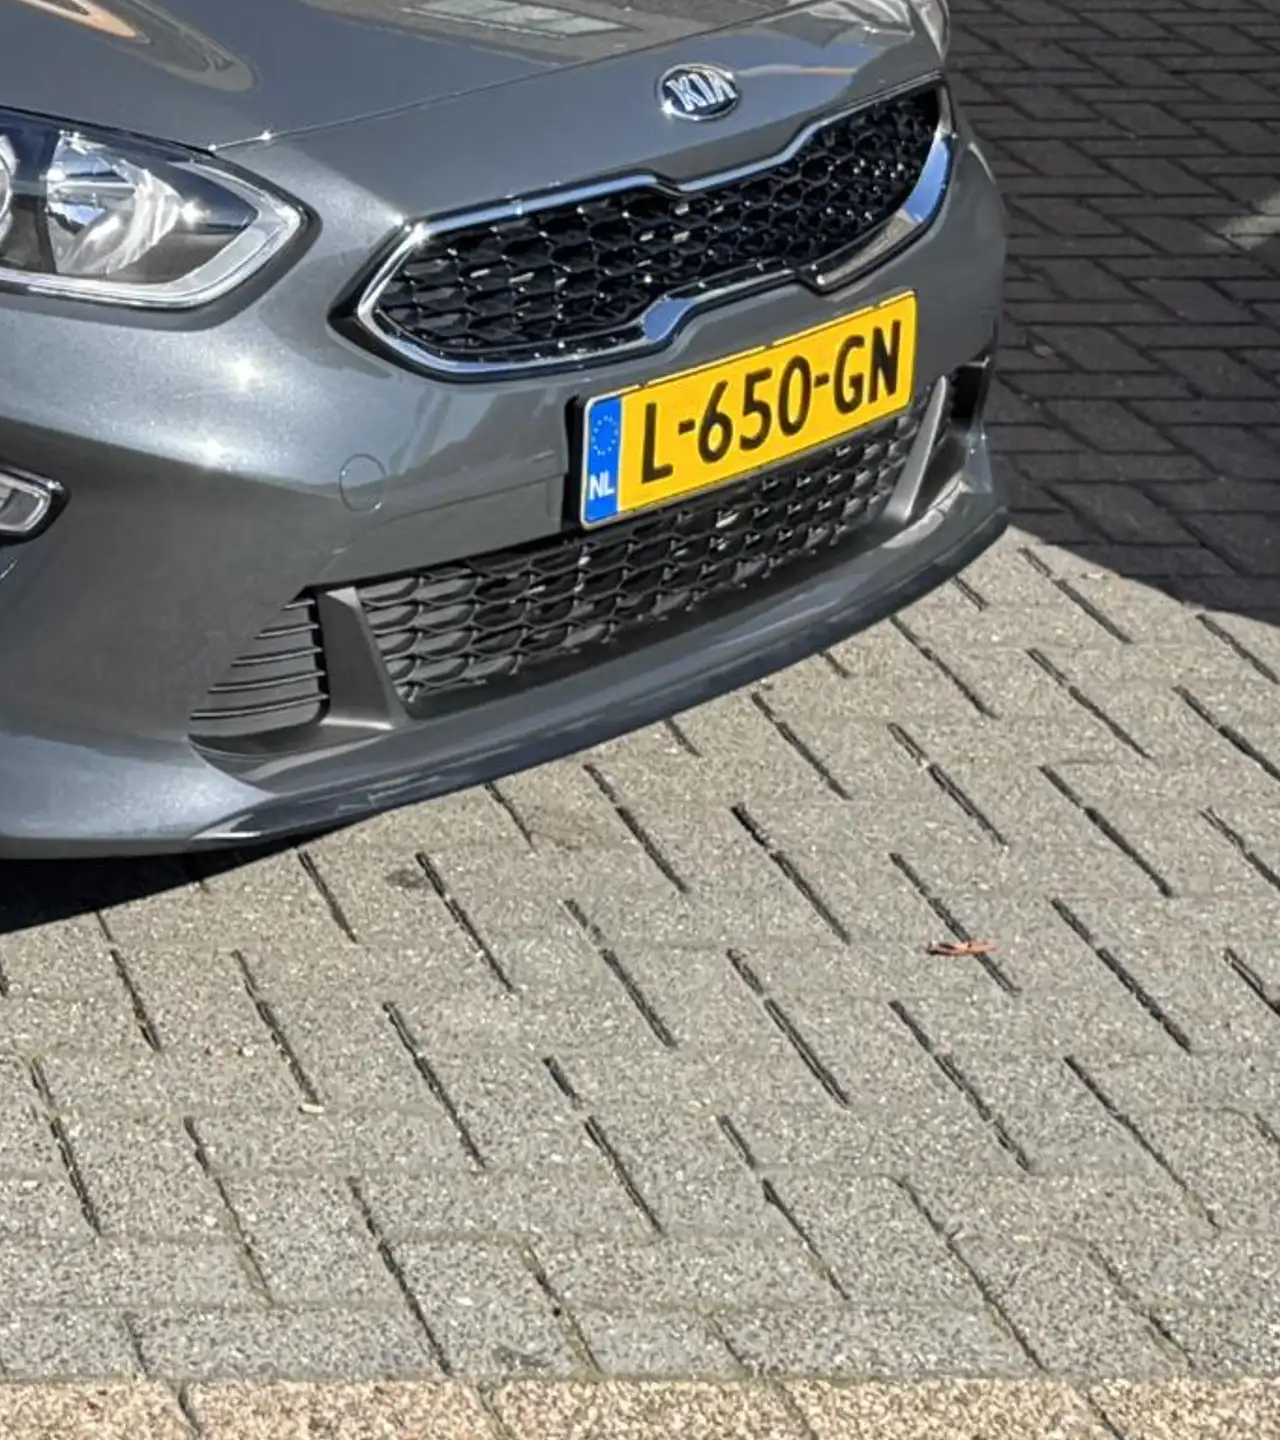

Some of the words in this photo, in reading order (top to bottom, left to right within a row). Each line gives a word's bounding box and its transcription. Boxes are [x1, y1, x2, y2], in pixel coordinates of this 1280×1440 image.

[665, 71, 737, 112] KIA
[640, 319, 902, 485] L-650-GN
[589, 471, 615, 501] NL
